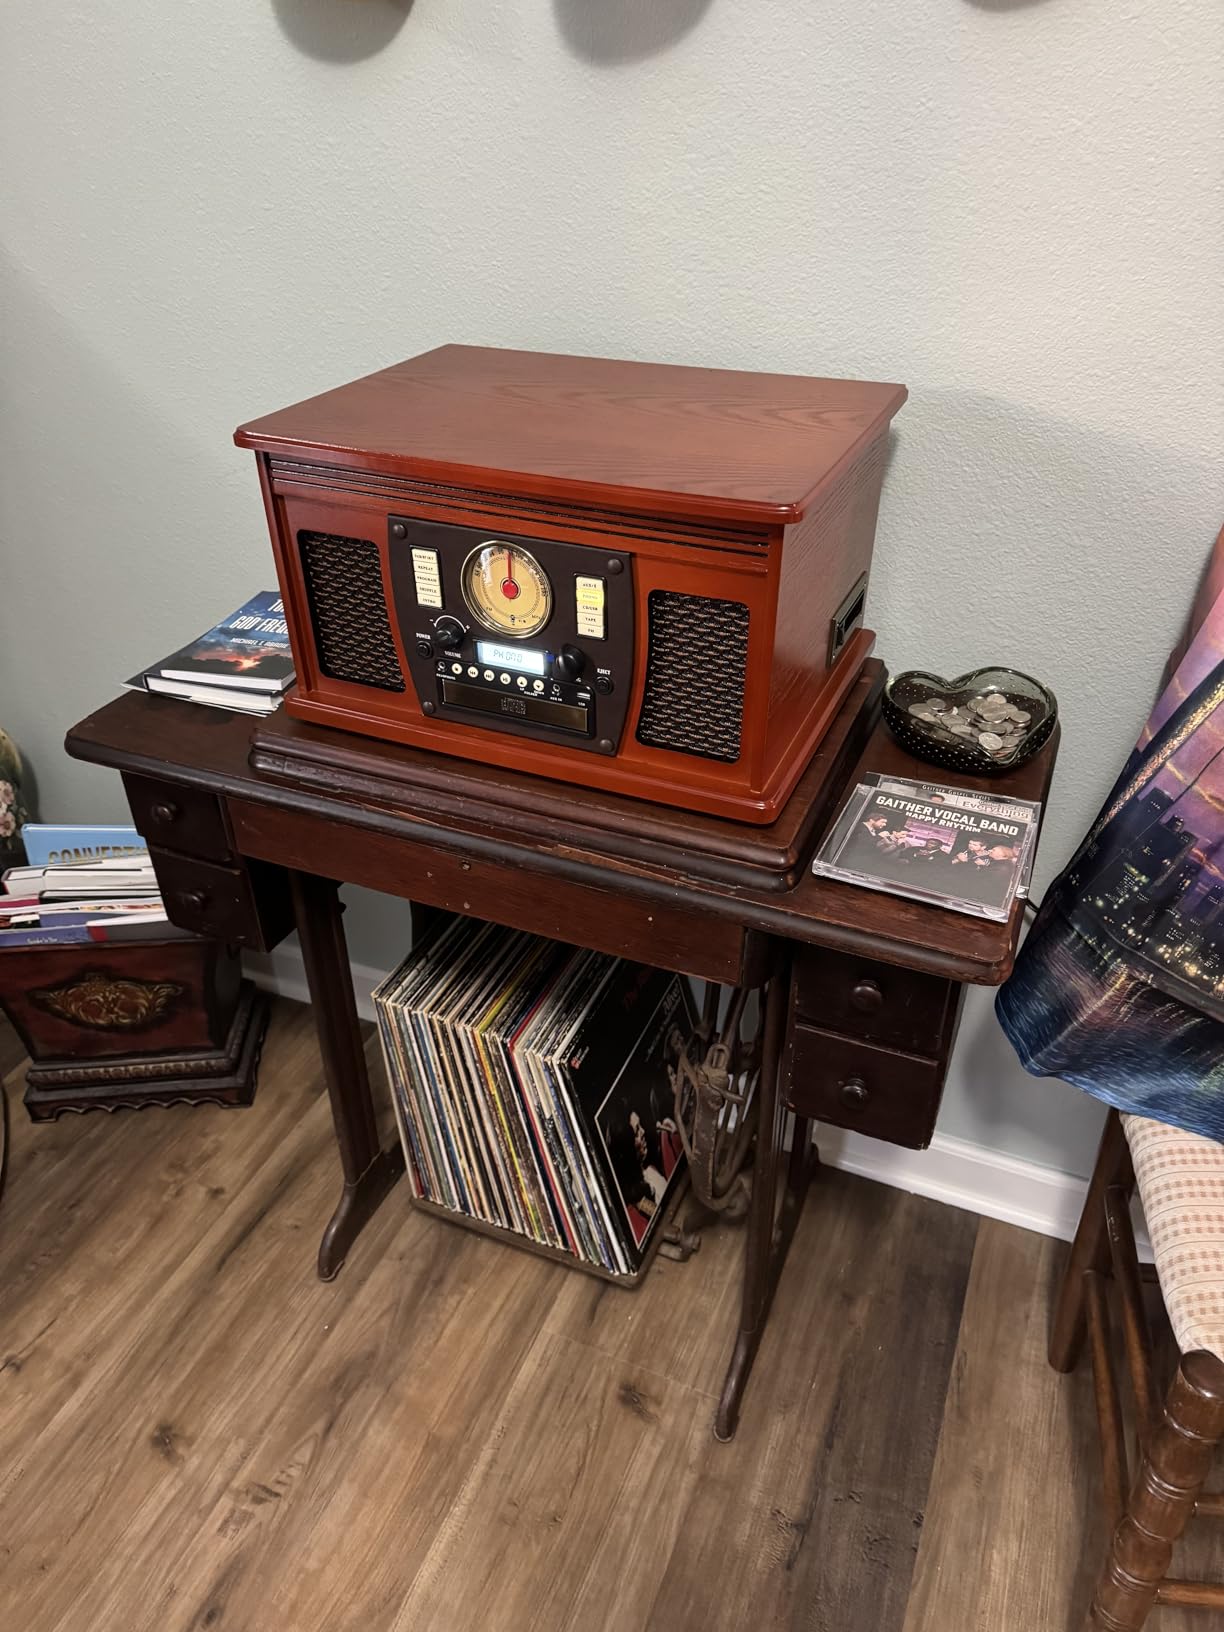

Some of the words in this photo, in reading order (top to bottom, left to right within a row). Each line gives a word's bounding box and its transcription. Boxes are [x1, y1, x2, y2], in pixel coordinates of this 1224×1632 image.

[230, 616, 262, 629] GOD
[415, 632, 431, 640] POWER
[444, 650, 462, 658] VOLUME
[597, 668, 611, 676] EJECT
[876, 795, 933, 816] GAITHER
[934, 807, 978, 827] VOCAL
[979, 819, 1019, 836] BAND
[905, 811, 938, 823] HAPPY
[938, 818, 982, 833] RHYTHM
